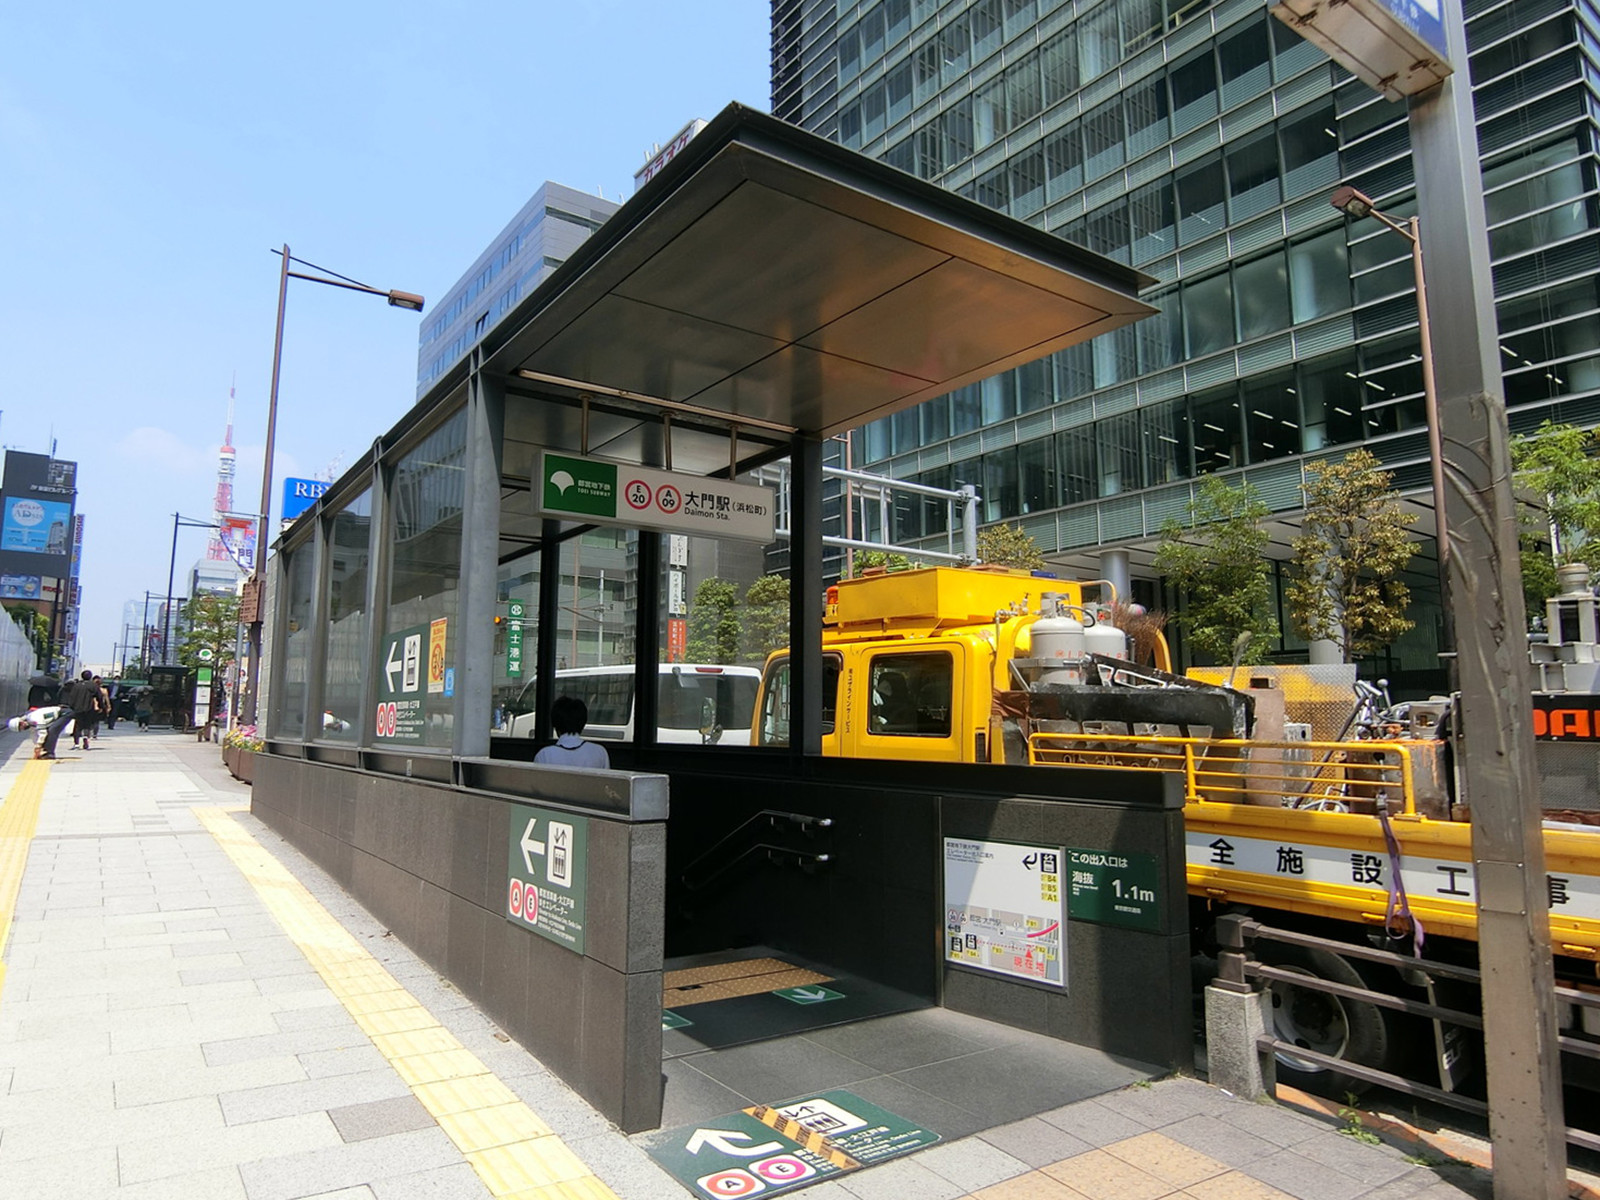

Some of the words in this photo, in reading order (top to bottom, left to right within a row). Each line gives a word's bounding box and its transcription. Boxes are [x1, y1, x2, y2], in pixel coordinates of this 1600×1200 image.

[644, 134, 690, 183] カラオケ
[632, 494, 645, 504] 20
[665, 490, 672, 498] A
[662, 498, 675, 508] 09
[684, 507, 714, 518] Daimon
[509, 620, 521, 672] 富士港運
[1071, 852, 1128, 868] この出入口は
[1072, 871, 1094, 885] 海抜
[1112, 879, 1155, 902] 1.1m
[775, 1164, 790, 1173] E
[724, 1180, 741, 1189] A
